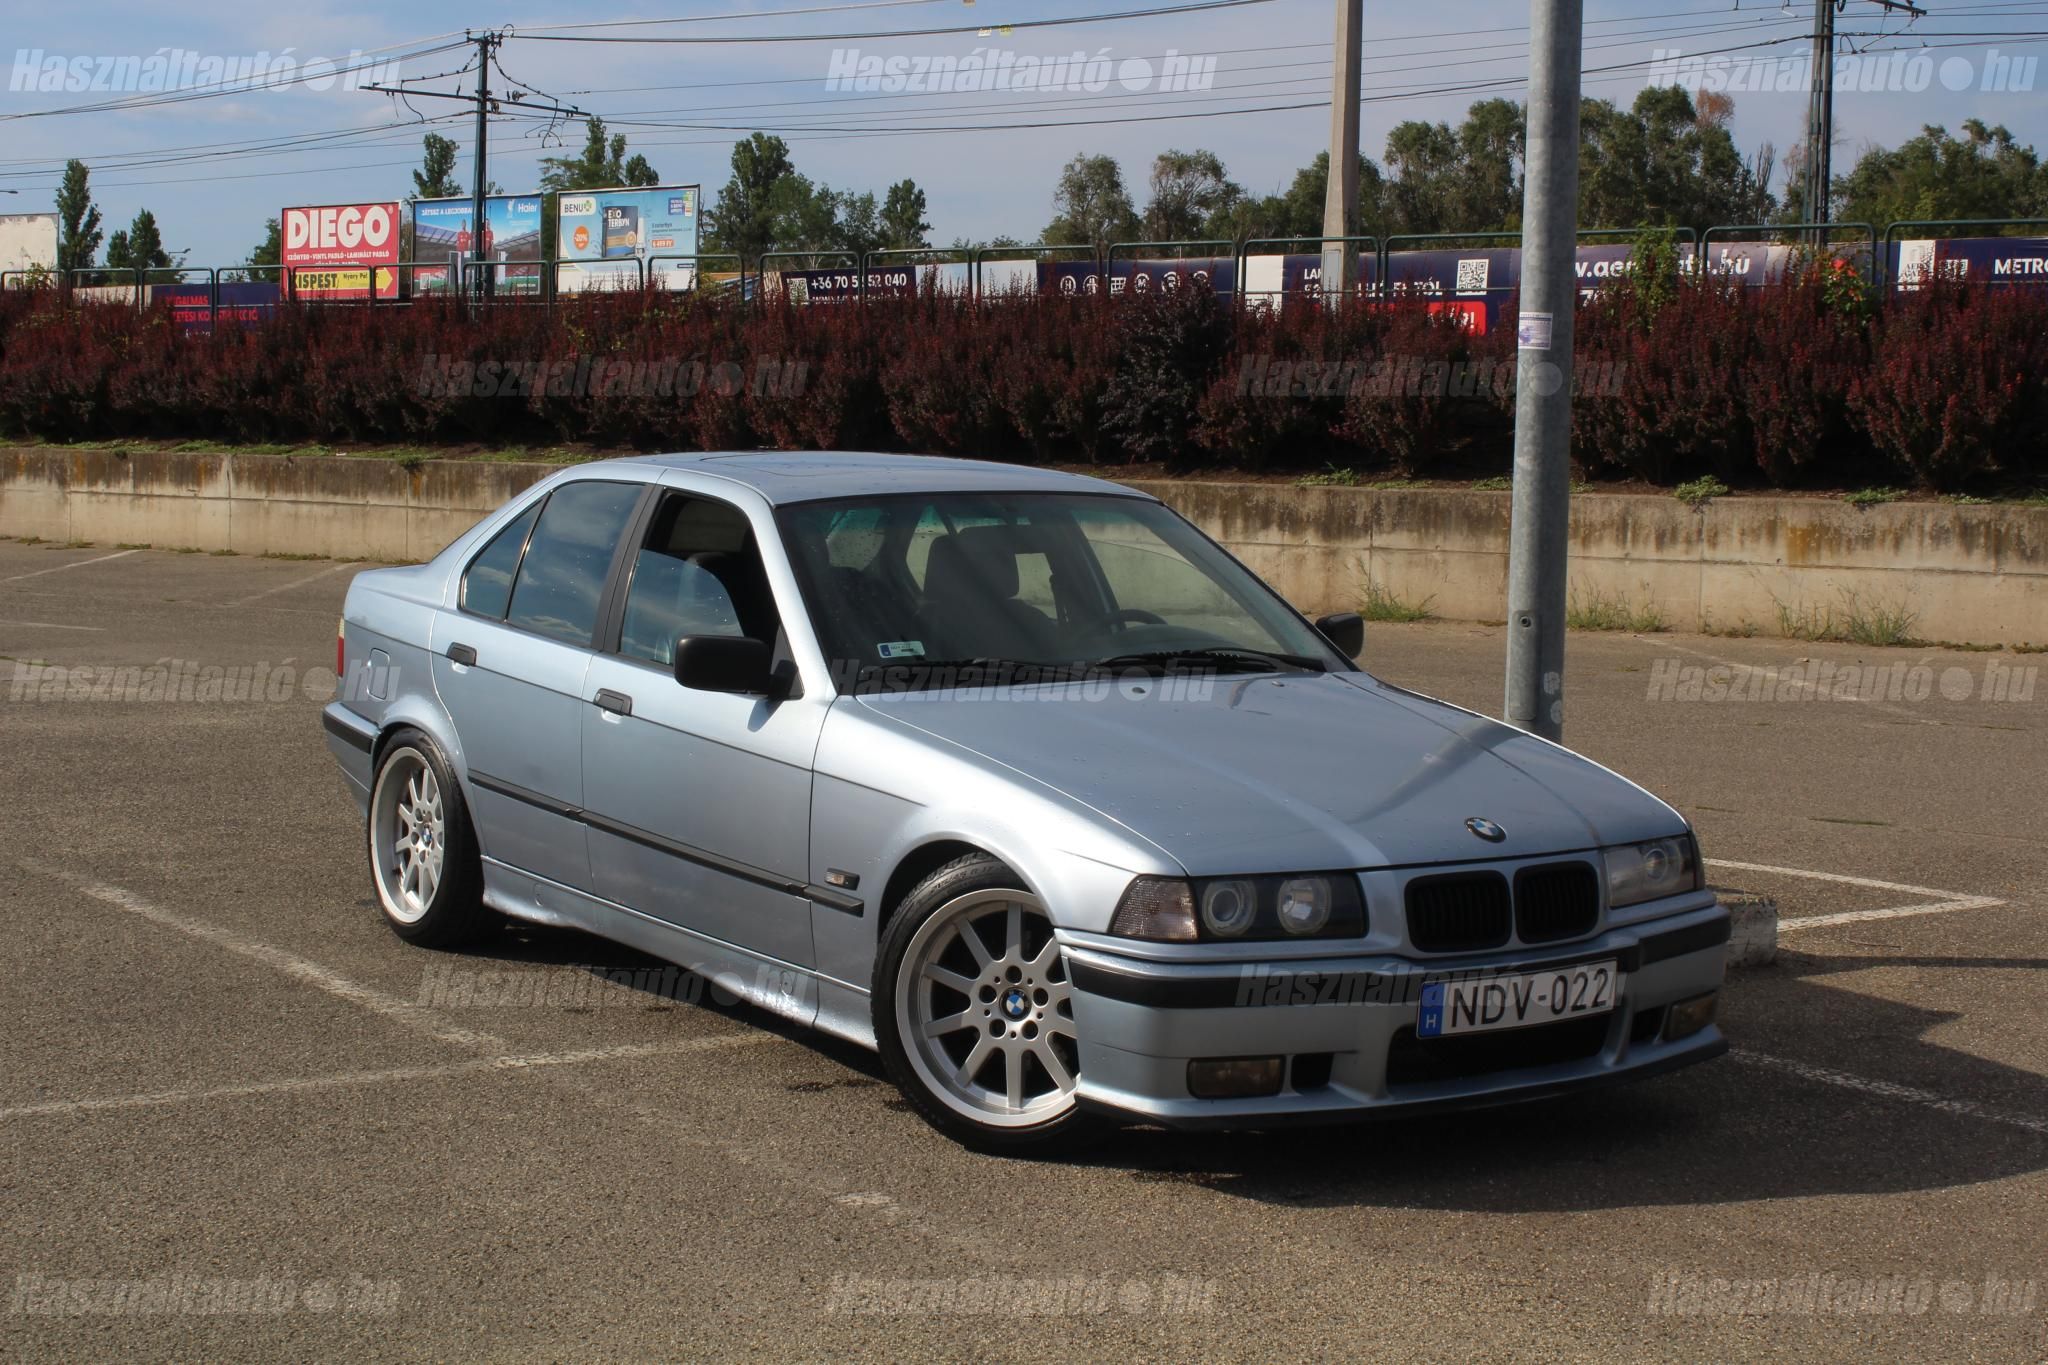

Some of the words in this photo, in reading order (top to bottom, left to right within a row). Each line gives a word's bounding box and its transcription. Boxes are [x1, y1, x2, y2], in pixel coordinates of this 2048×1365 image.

[518, 203, 538, 214] Haier
[564, 203, 584, 213] BENU
[287, 206, 390, 250] DIEGO
[811, 277, 832, 290] +36
[834, 275, 848, 289] 70
[885, 273, 907, 287] 040
[1452, 968, 1609, 1028] NDV-022
[1425, 1013, 1437, 1030] H
